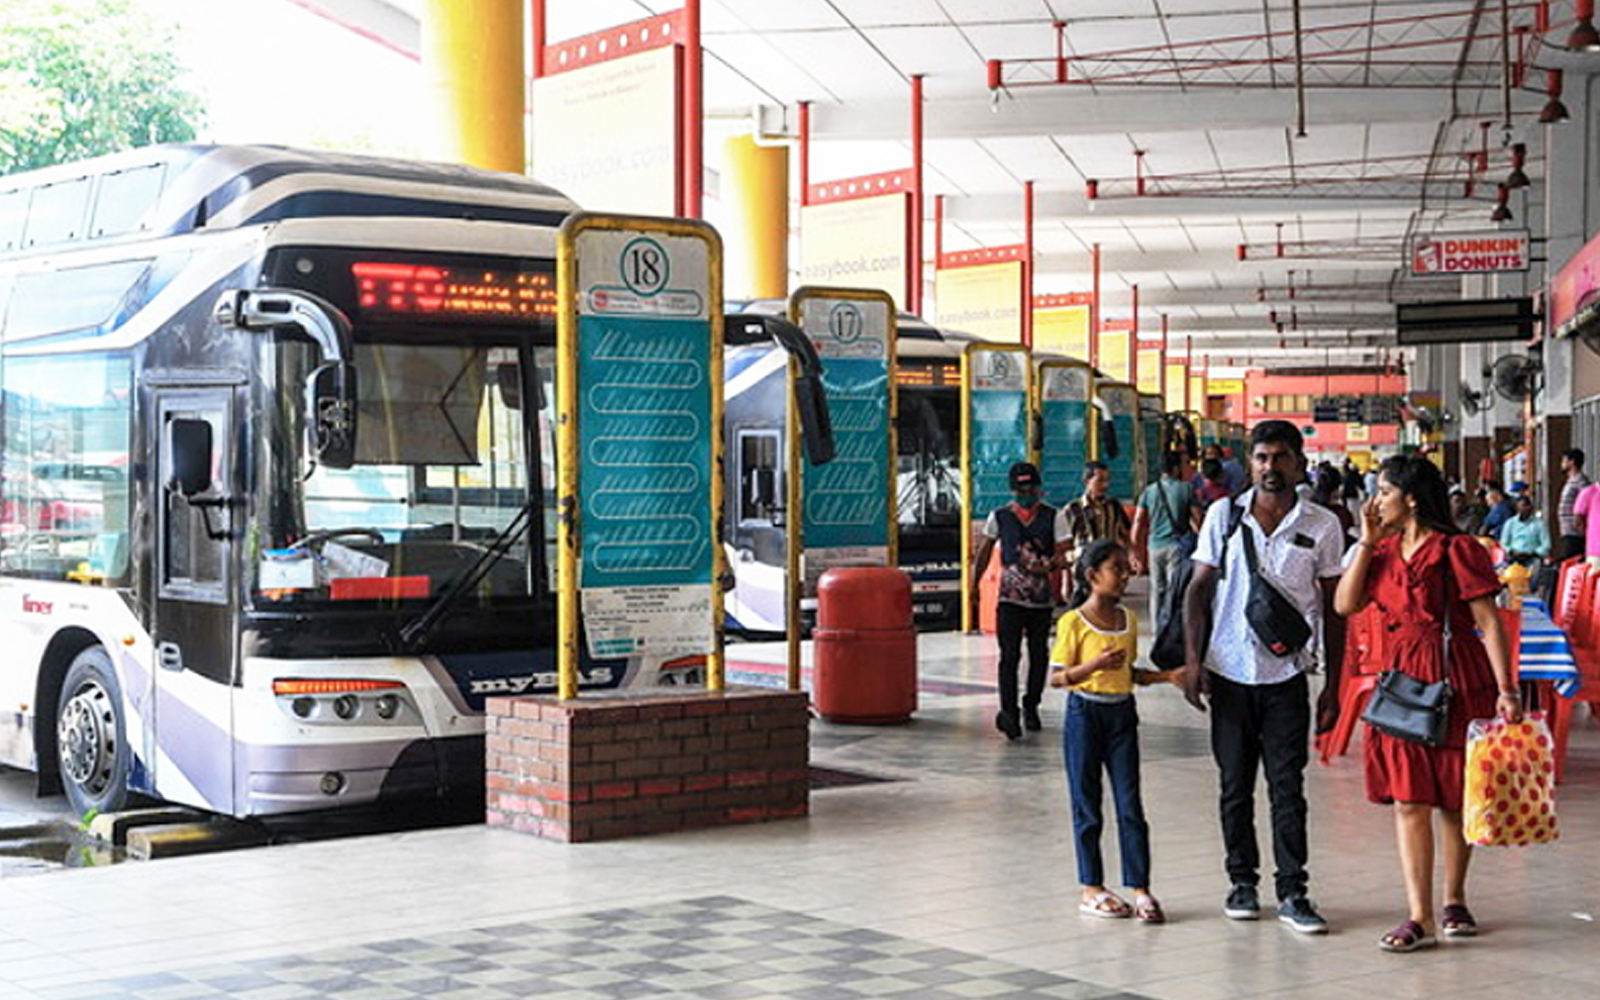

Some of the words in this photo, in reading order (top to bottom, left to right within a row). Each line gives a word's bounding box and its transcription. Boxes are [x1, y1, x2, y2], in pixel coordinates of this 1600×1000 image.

[1444, 238, 1526, 255] DUNKIN'
[632, 248, 660, 286] 18
[804, 254, 901, 282] easybook.com
[1444, 254, 1522, 271] DONUTS
[837, 310, 856, 337] 17
